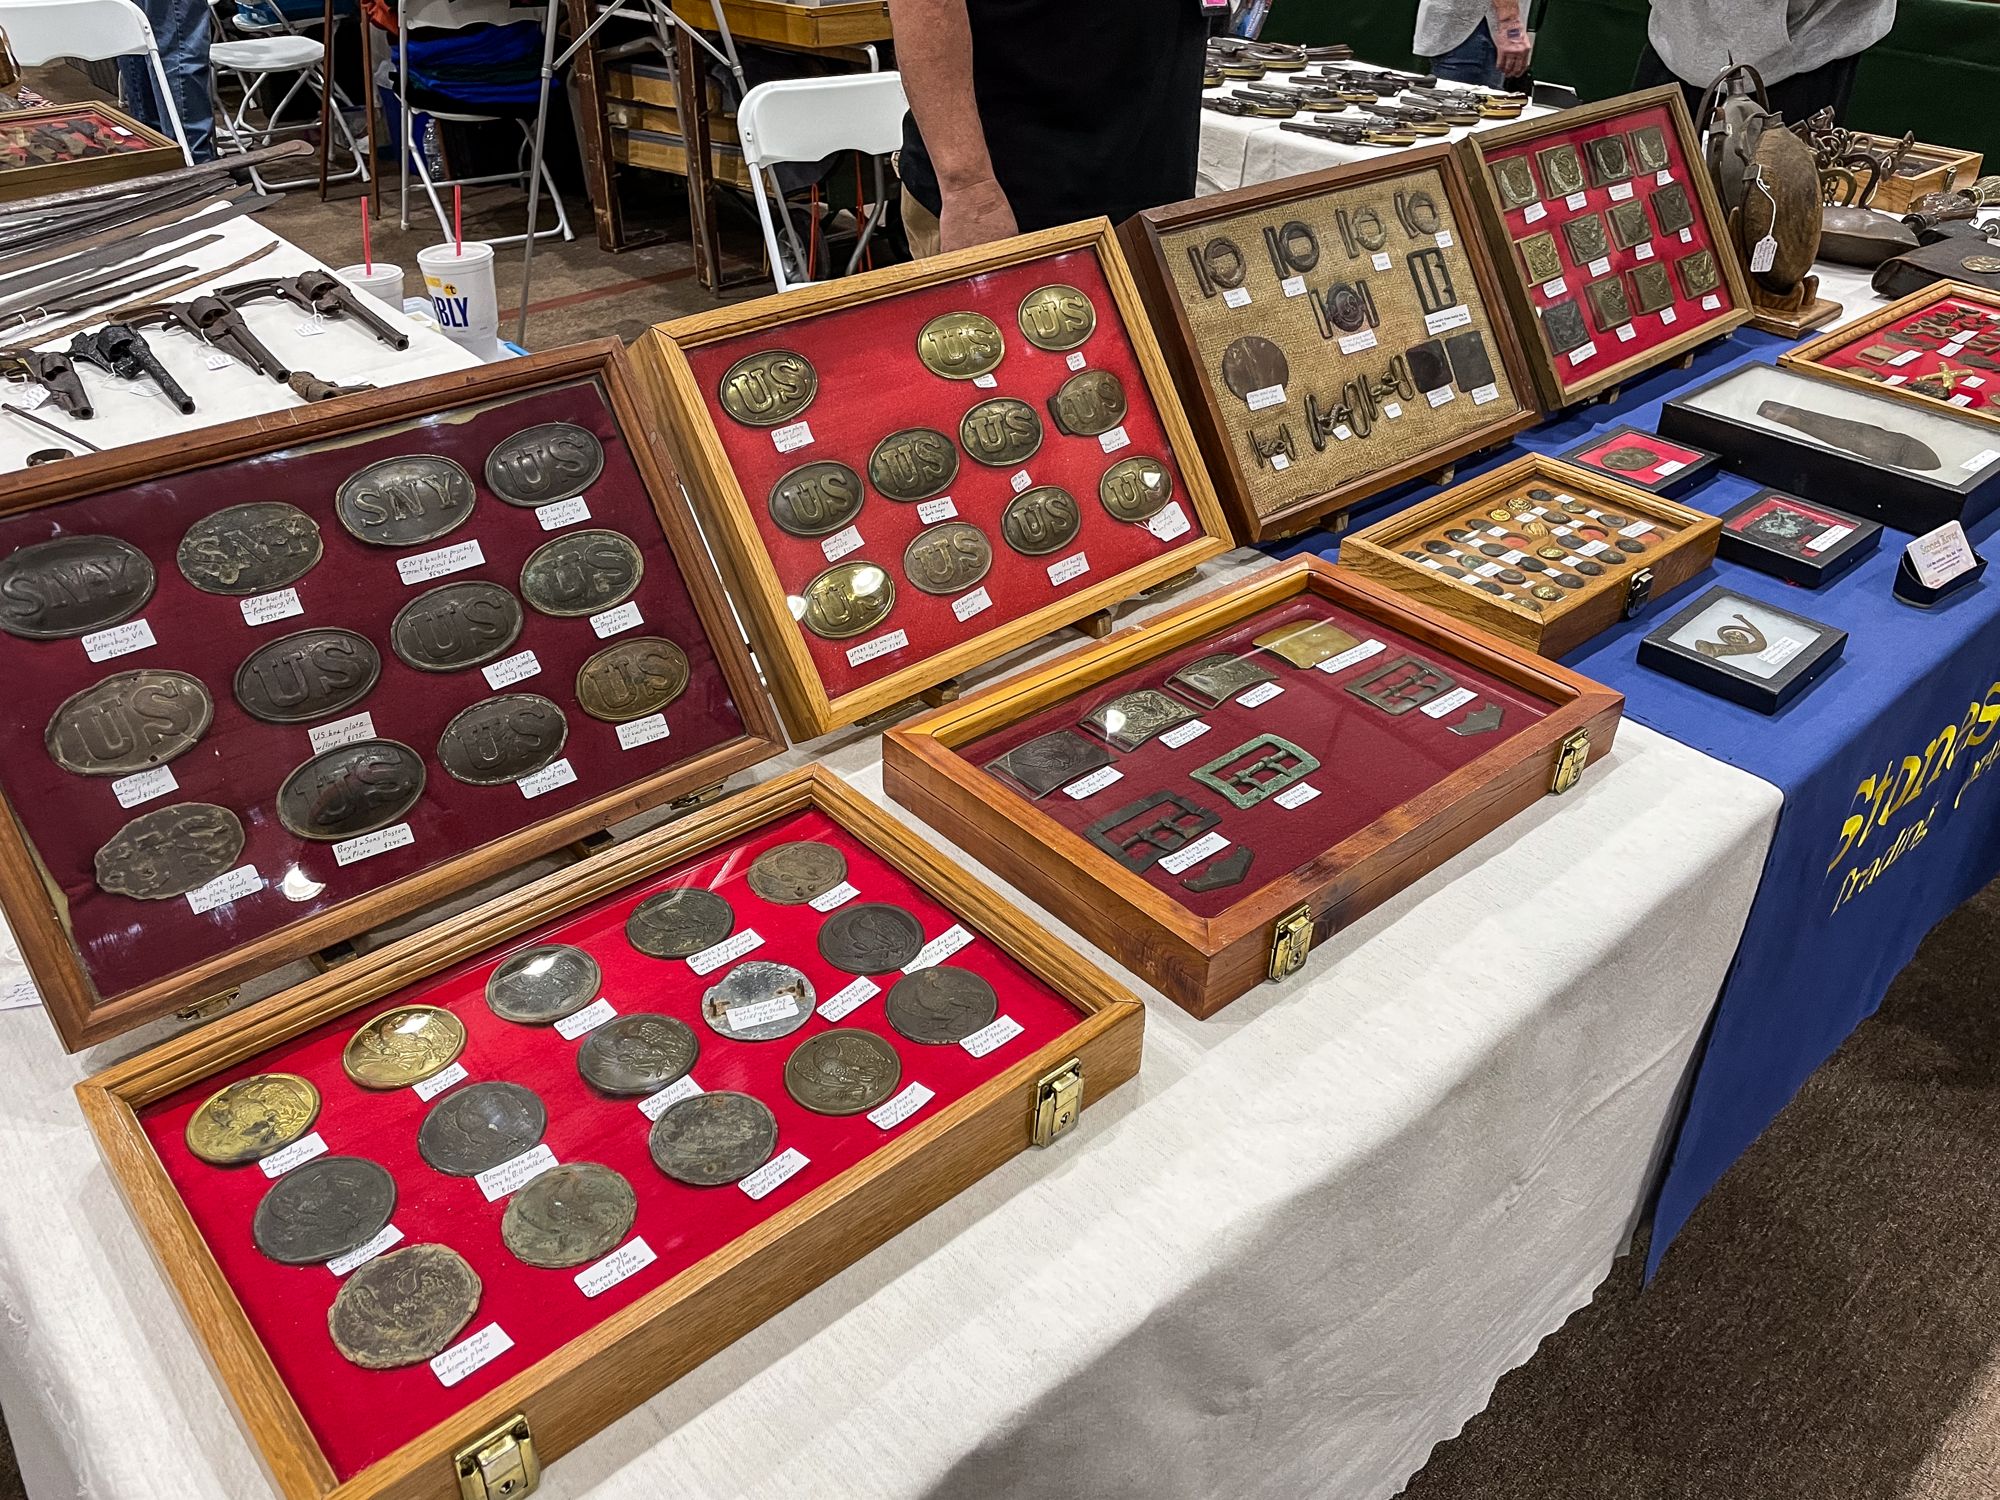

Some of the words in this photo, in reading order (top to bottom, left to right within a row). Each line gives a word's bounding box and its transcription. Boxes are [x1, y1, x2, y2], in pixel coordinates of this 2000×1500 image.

[1026, 296, 1089, 339] US
[927, 325, 997, 366] US
[731, 358, 806, 413] US
[1066, 380, 1120, 422] US
[967, 407, 1034, 453] US
[501, 436, 584, 495] US
[881, 435, 943, 490] US
[354, 471, 457, 526] SNY
[782, 471, 848, 525] US
[1012, 494, 1076, 543] US
[1, 552, 131, 617] SNY
[402, 560, 423, 569] SNY
[912, 531, 986, 585] US
[244, 597, 263, 609] SNY
[408, 599, 505, 659] US
[253, 638, 360, 707] US
[587, 651, 671, 708] US
[74, 679, 191, 761] US
[312, 731, 326, 741] US
[452, 704, 545, 770] US
[605, 1251, 628, 1273] eagle
